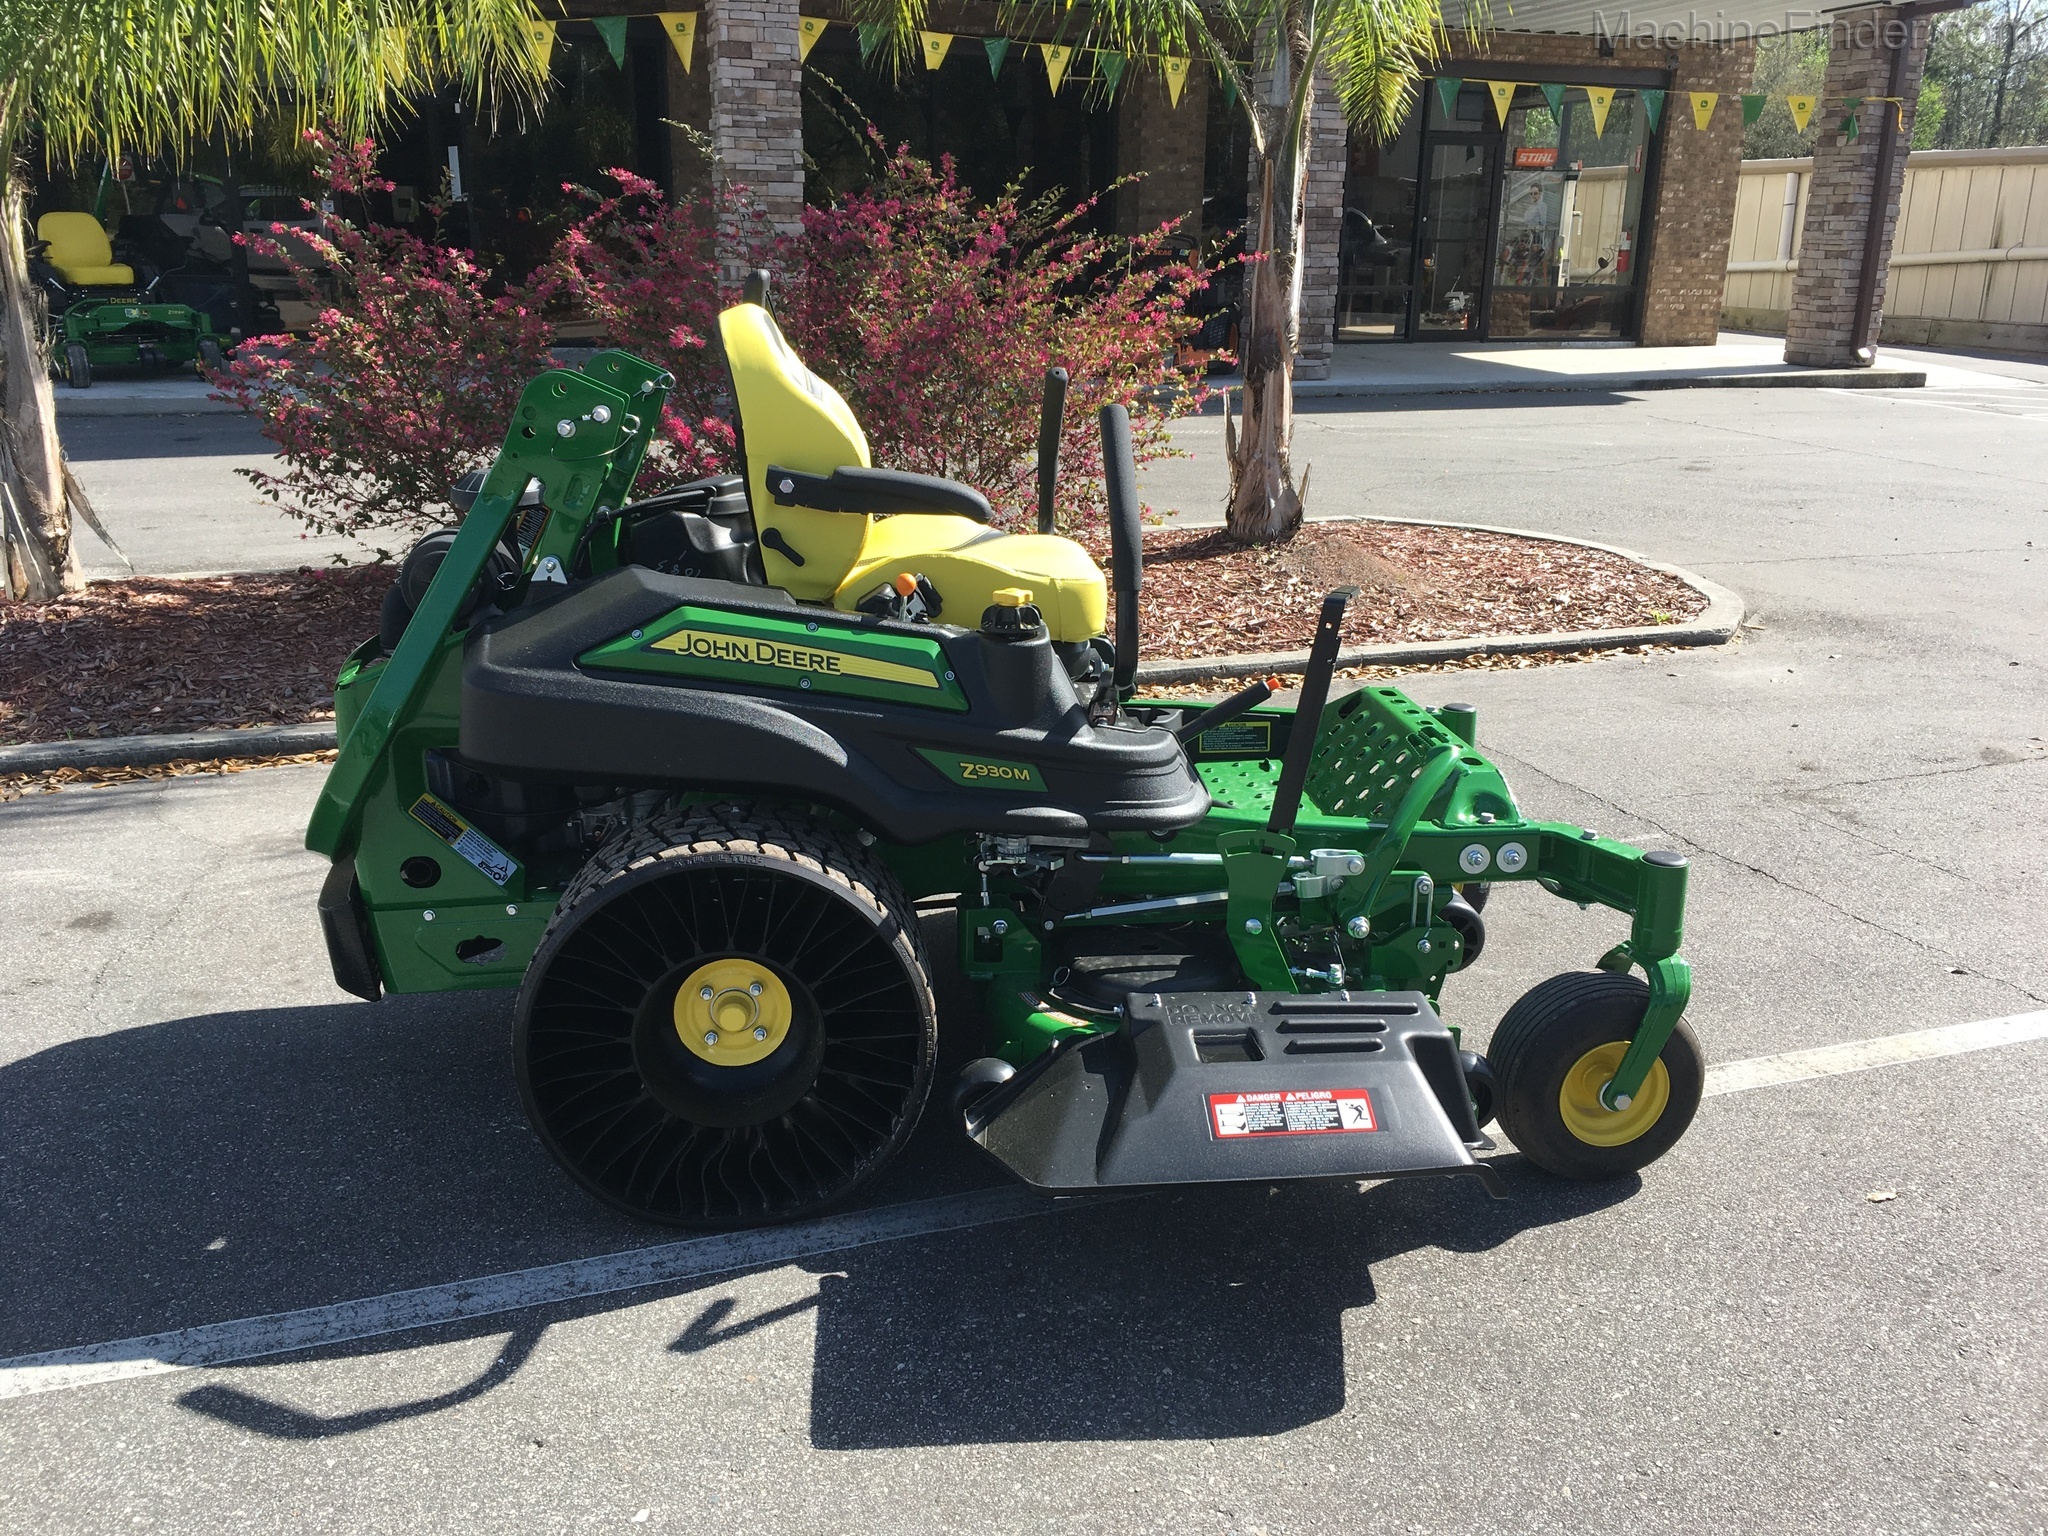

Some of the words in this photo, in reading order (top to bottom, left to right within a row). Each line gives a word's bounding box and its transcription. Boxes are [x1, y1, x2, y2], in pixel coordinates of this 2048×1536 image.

[1518, 152, 1554, 163] STIHL
[677, 633, 750, 660] JOHN
[755, 642, 841, 672] DEERE
[959, 762, 1031, 781] Z930M
[436, 804, 458, 823] CAUTION
[1165, 1004, 1200, 1016] DO
[1212, 1003, 1256, 1015] NOT
[1168, 1013, 1265, 1026] REMOVE
[1246, 1093, 1282, 1102] DANGER
[1295, 1091, 1333, 1100] PELIGRO
